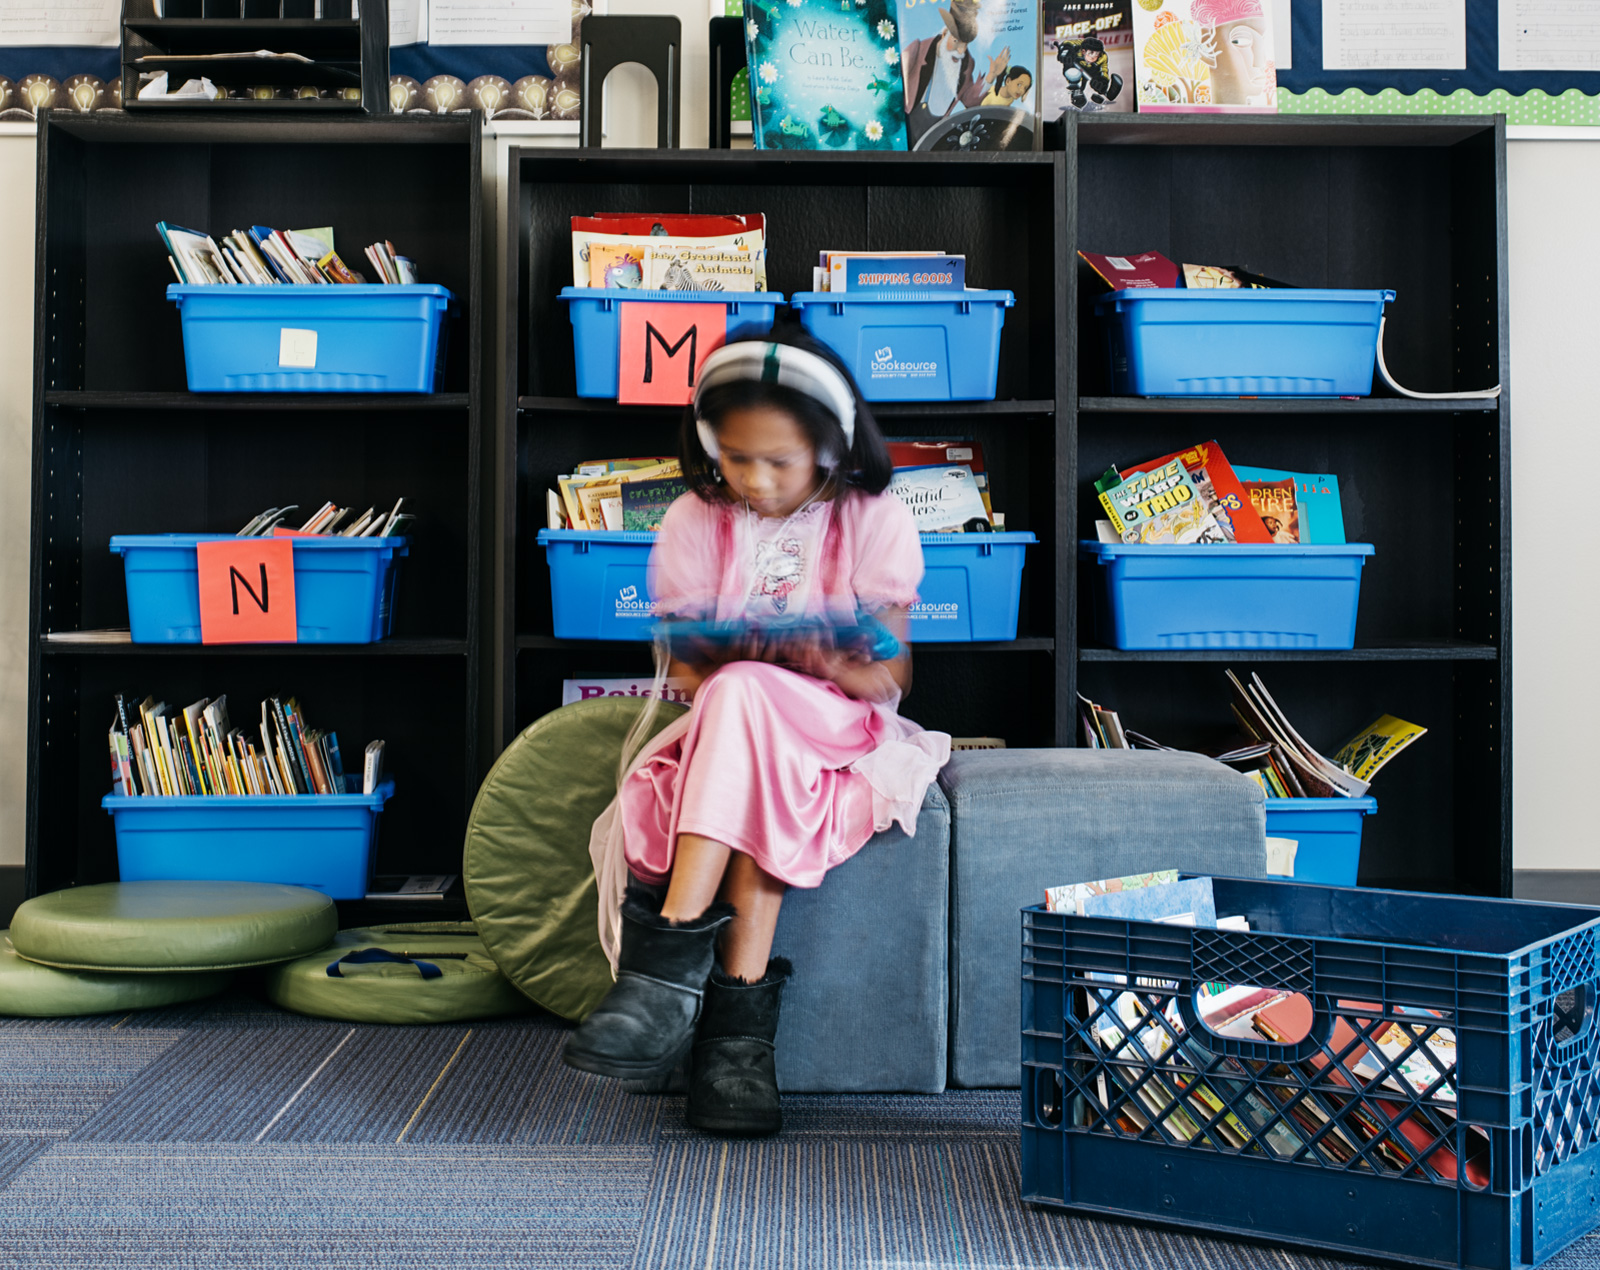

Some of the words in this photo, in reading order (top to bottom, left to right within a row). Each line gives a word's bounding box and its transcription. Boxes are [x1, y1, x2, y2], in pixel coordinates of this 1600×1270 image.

[794, 19, 858, 42] Water
[1055, 13, 1122, 39] FACE-OFF
[789, 42, 832, 66] Can
[651, 251, 676, 261] Baby
[679, 250, 752, 262] Grassland
[694, 263, 754, 274] Animals
[858, 272, 910, 286] SHIPPING
[912, 272, 953, 284] GOODS
[642, 320, 698, 388] M
[871, 360, 938, 370] booksource
[1112, 488, 1127, 500] THE
[1126, 462, 1179, 494] TIME
[1120, 474, 1184, 508] WARP
[1136, 484, 1193, 518] TRIO
[1248, 486, 1292, 499] DREN
[1250, 498, 1294, 512] FIRE
[230, 562, 269, 615] N
[908, 601, 958, 612] oksource
[577, 684, 694, 702] Raisin
[285, 739, 296, 761] MOON
